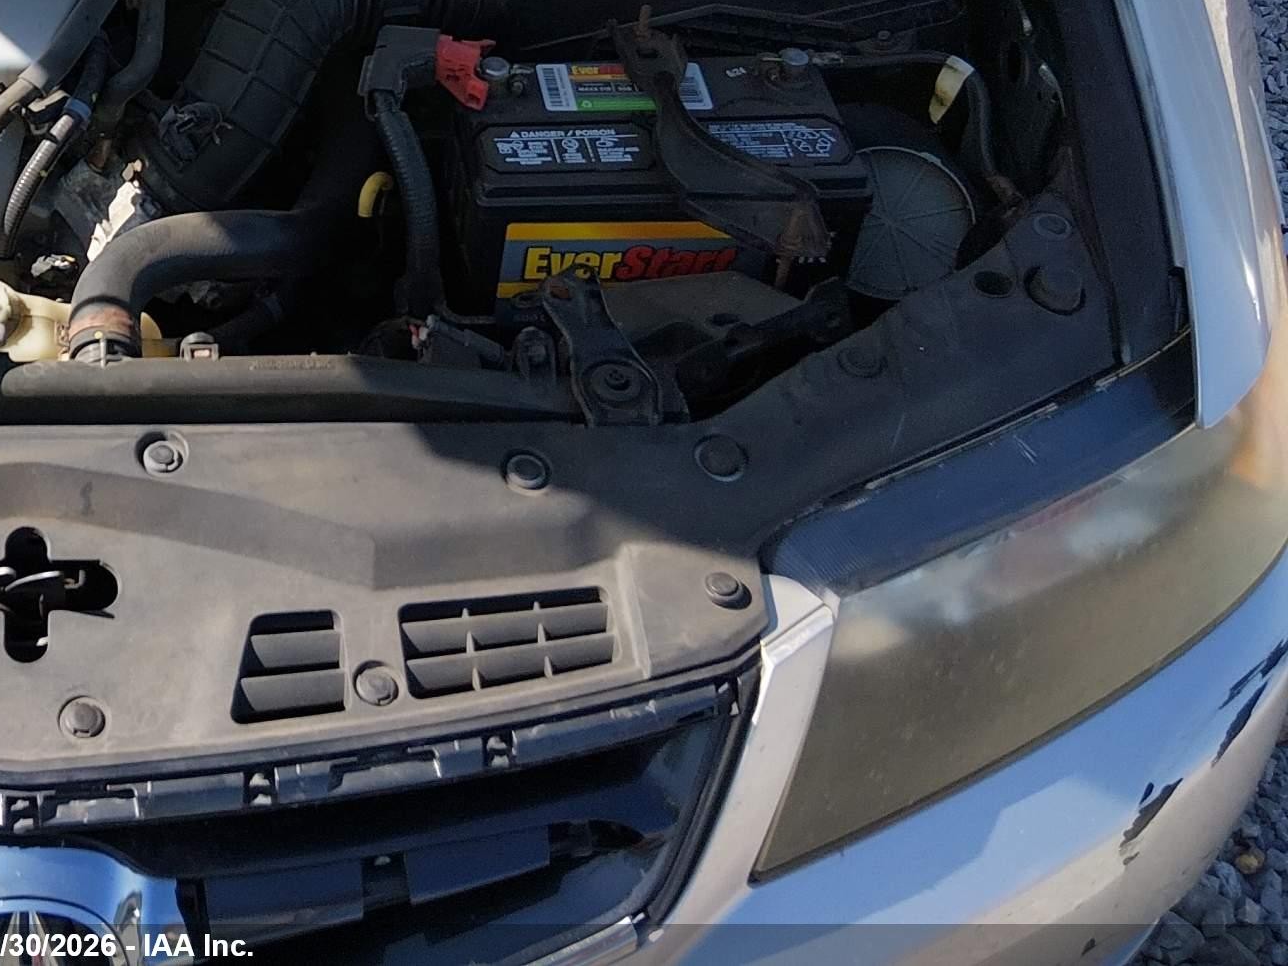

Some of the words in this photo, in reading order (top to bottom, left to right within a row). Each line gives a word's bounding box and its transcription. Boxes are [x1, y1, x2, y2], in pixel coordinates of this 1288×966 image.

[520, 130, 565, 138] DANGER
[574, 128, 617, 137] POISON
[523, 245, 737, 281] EverStart
